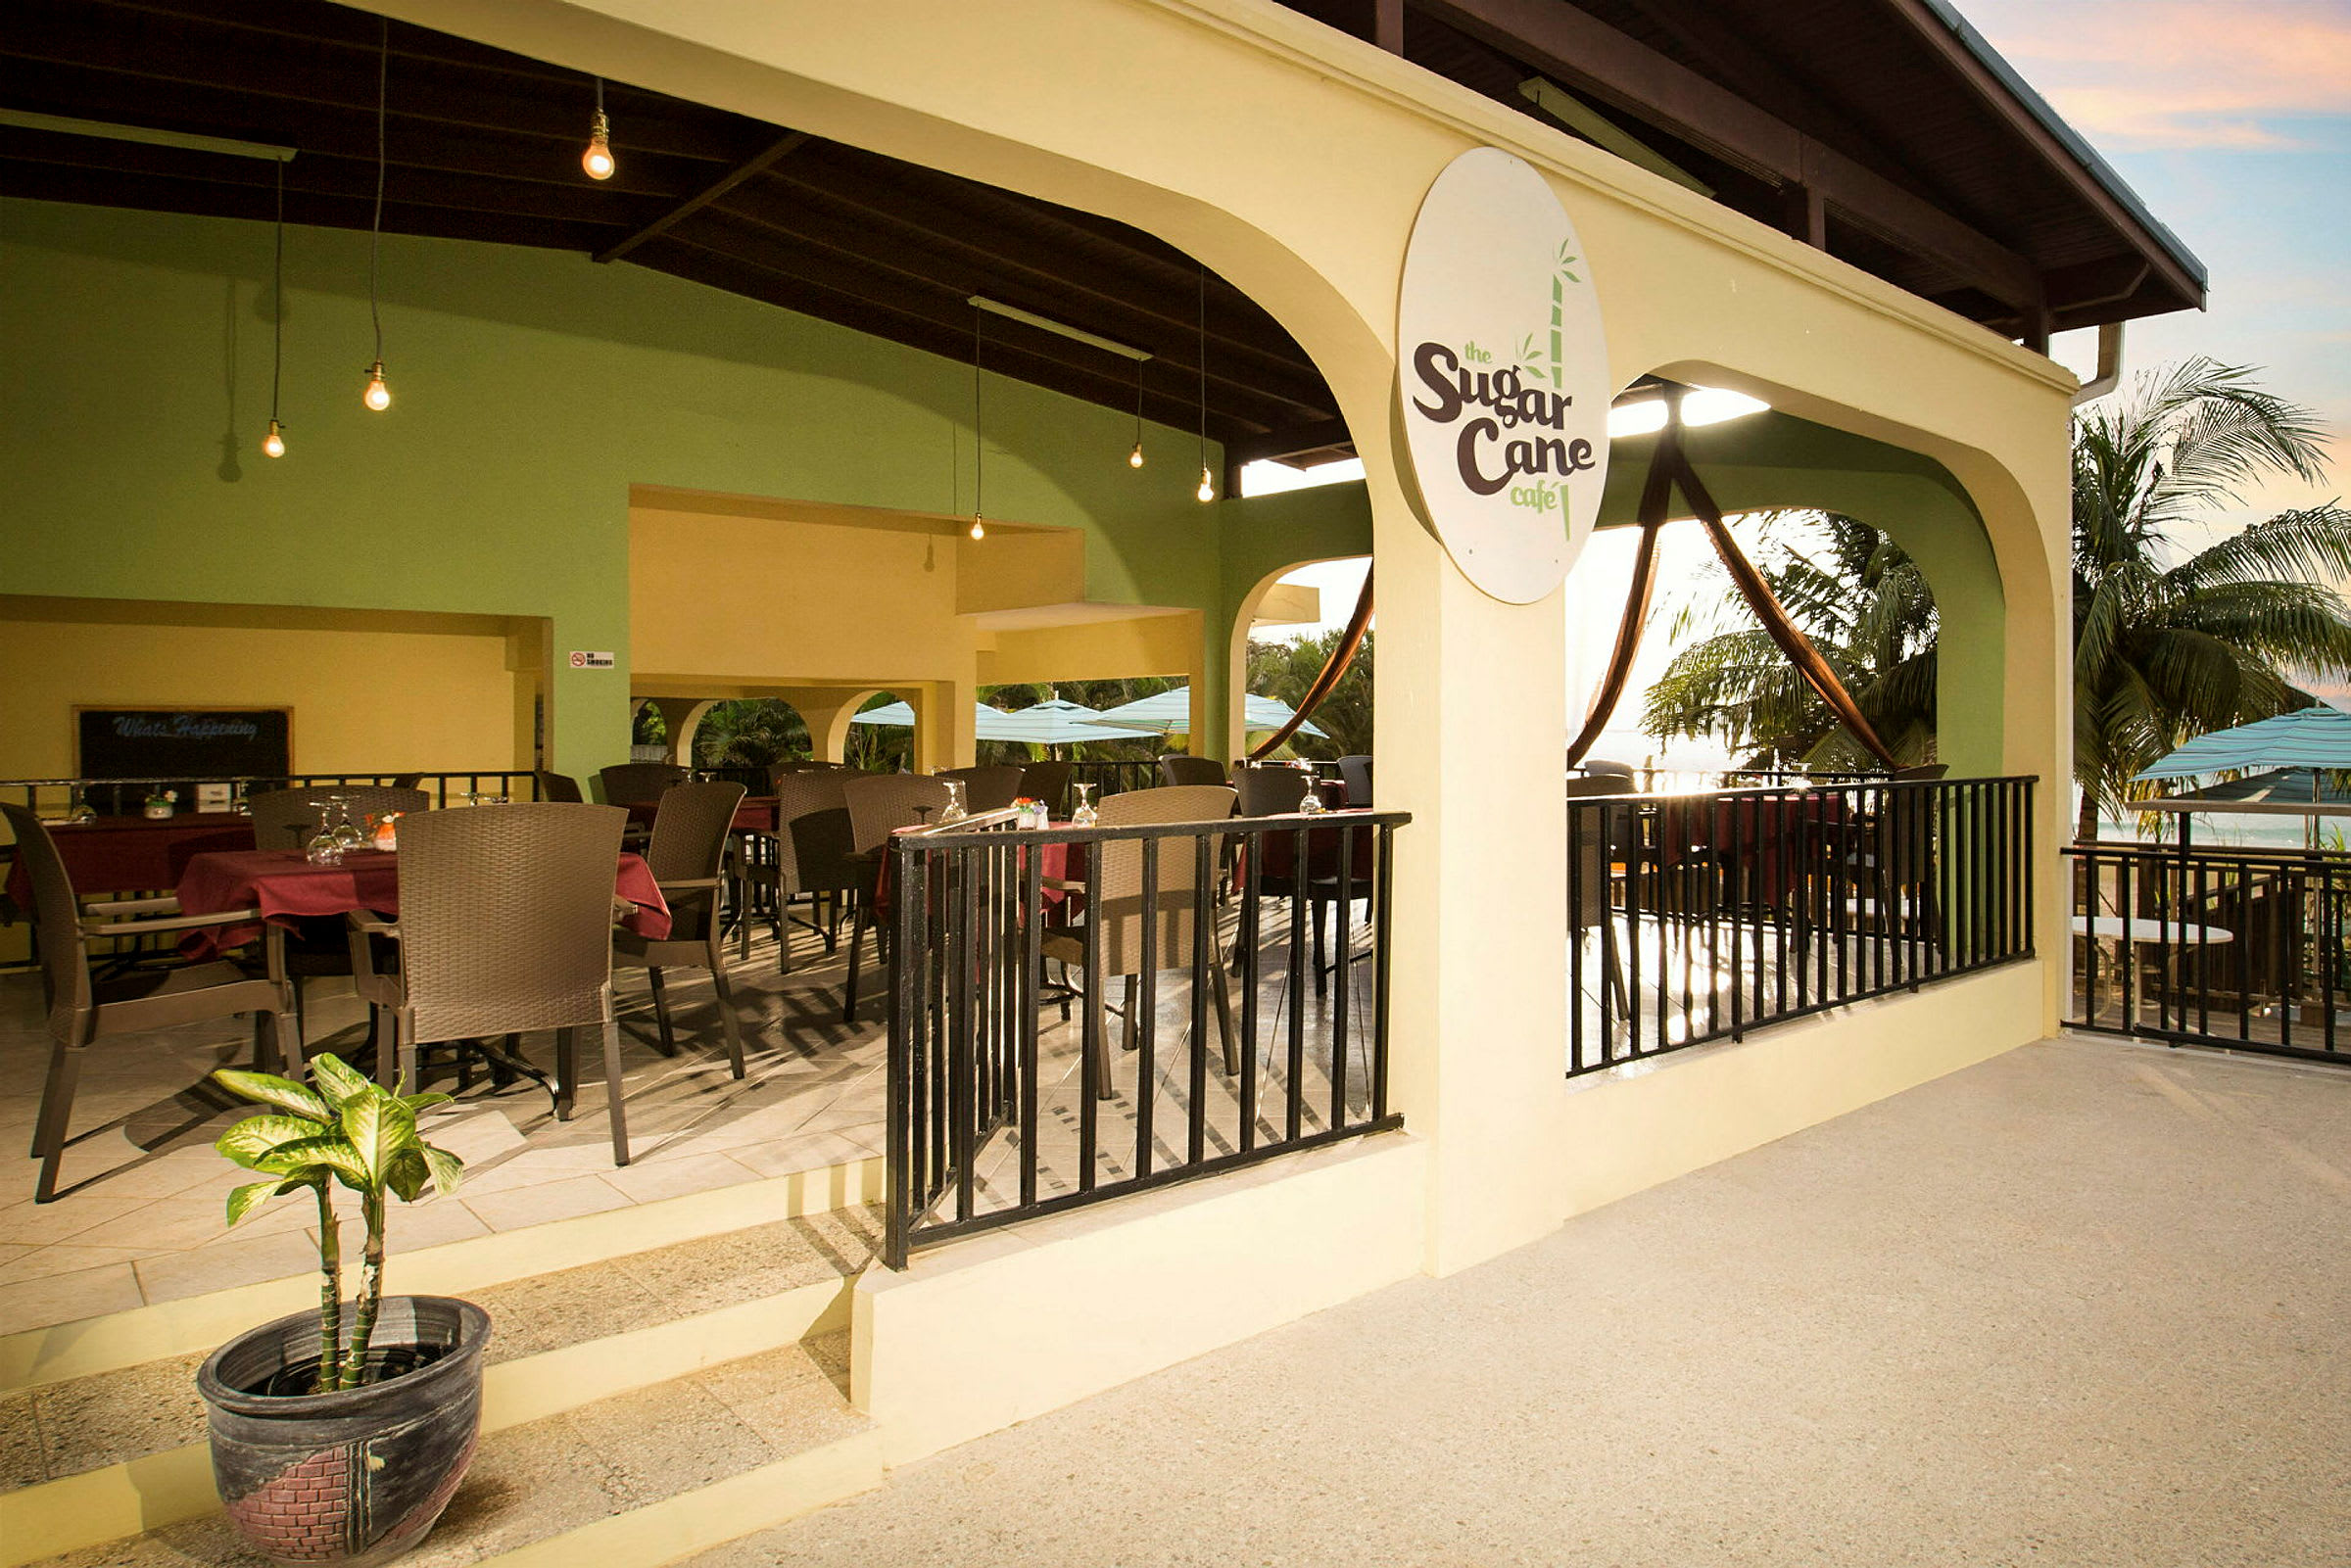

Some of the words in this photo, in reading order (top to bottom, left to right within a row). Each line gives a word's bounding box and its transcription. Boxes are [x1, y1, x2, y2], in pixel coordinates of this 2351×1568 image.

[1464, 341, 1492, 364] the
[1413, 342, 1572, 430] Sugar
[1457, 417, 1596, 496] Cane
[1510, 480, 1559, 513] café
